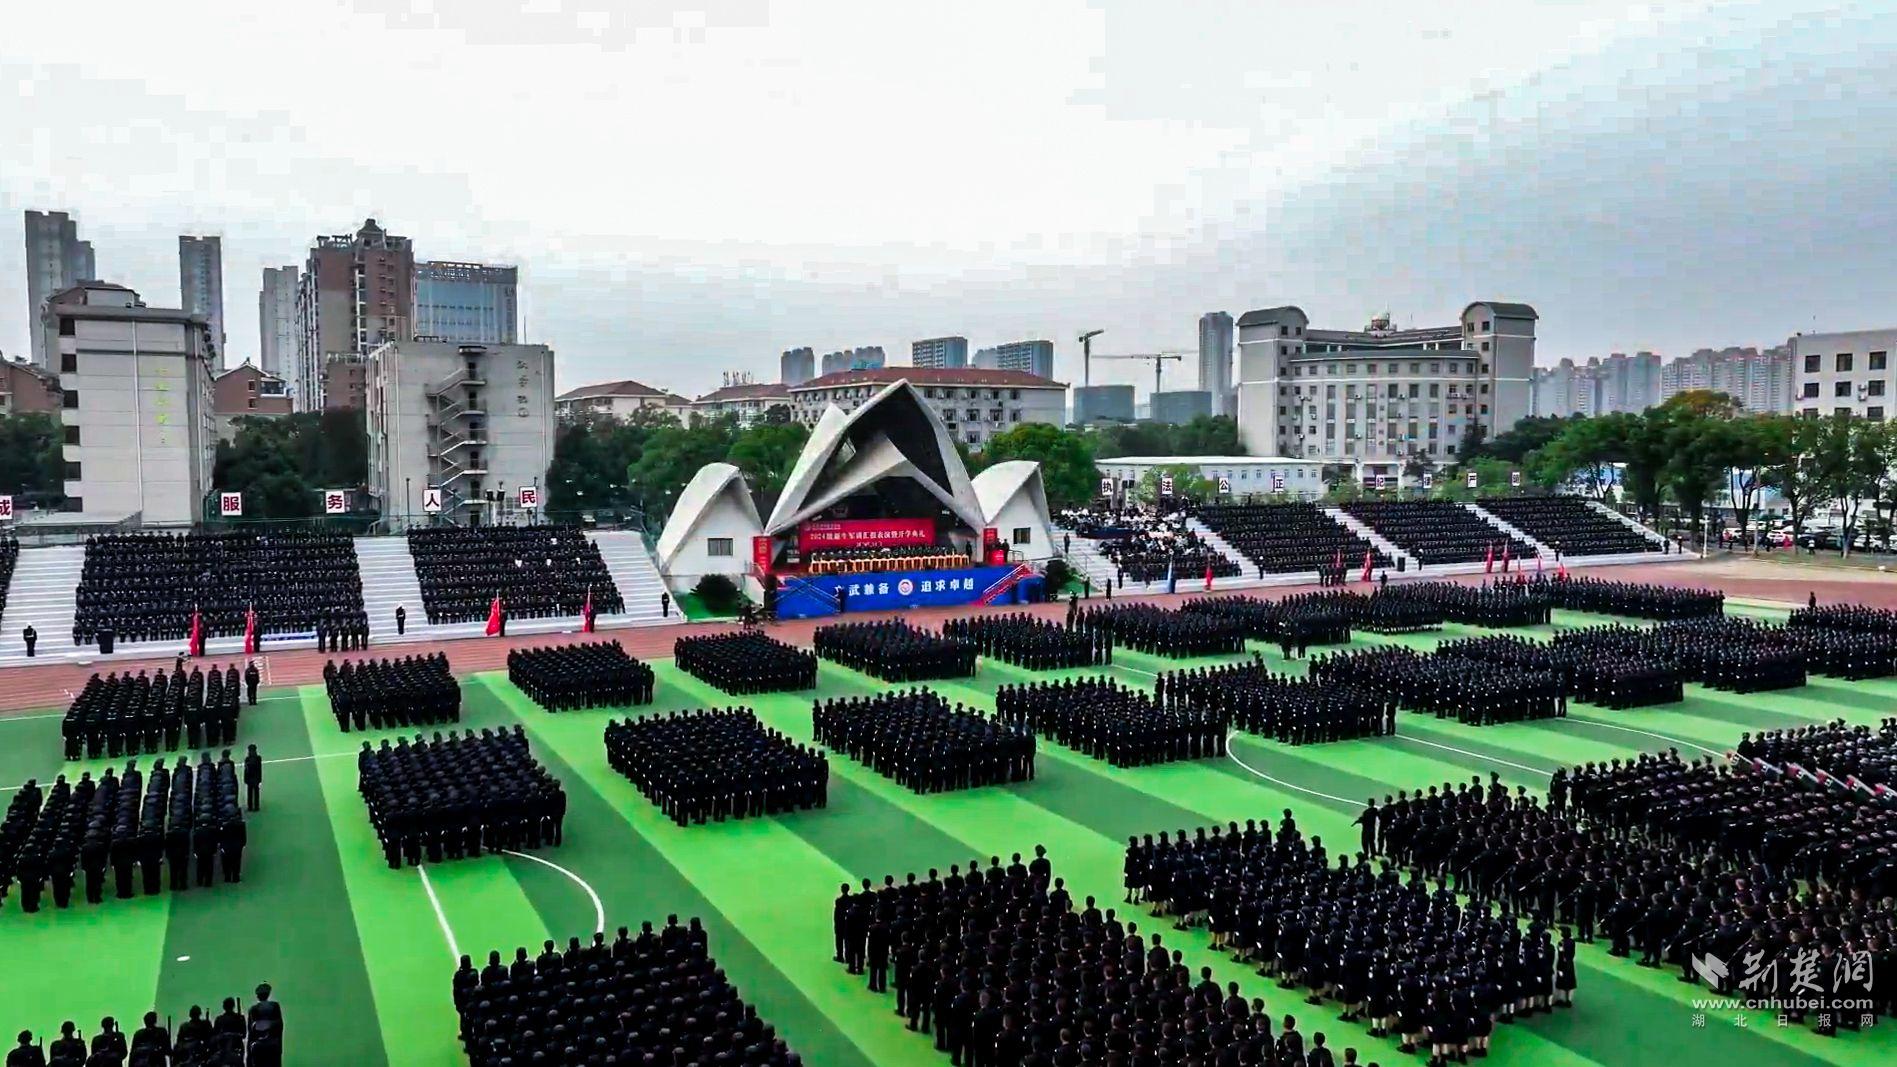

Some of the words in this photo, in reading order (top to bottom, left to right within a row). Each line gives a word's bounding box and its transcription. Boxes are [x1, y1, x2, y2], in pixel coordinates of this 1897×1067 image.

[1102, 481, 1112, 493] 执
[1162, 480, 1172, 492] 法
[1219, 479, 1229, 490] 公
[1275, 478, 1284, 488] 正
[223, 496, 240, 511] 服
[327, 494, 344, 509] 务
[425, 493, 440, 508] 人
[522, 490, 536, 504] 民
[920, 577, 974, 593] 追求卓越
